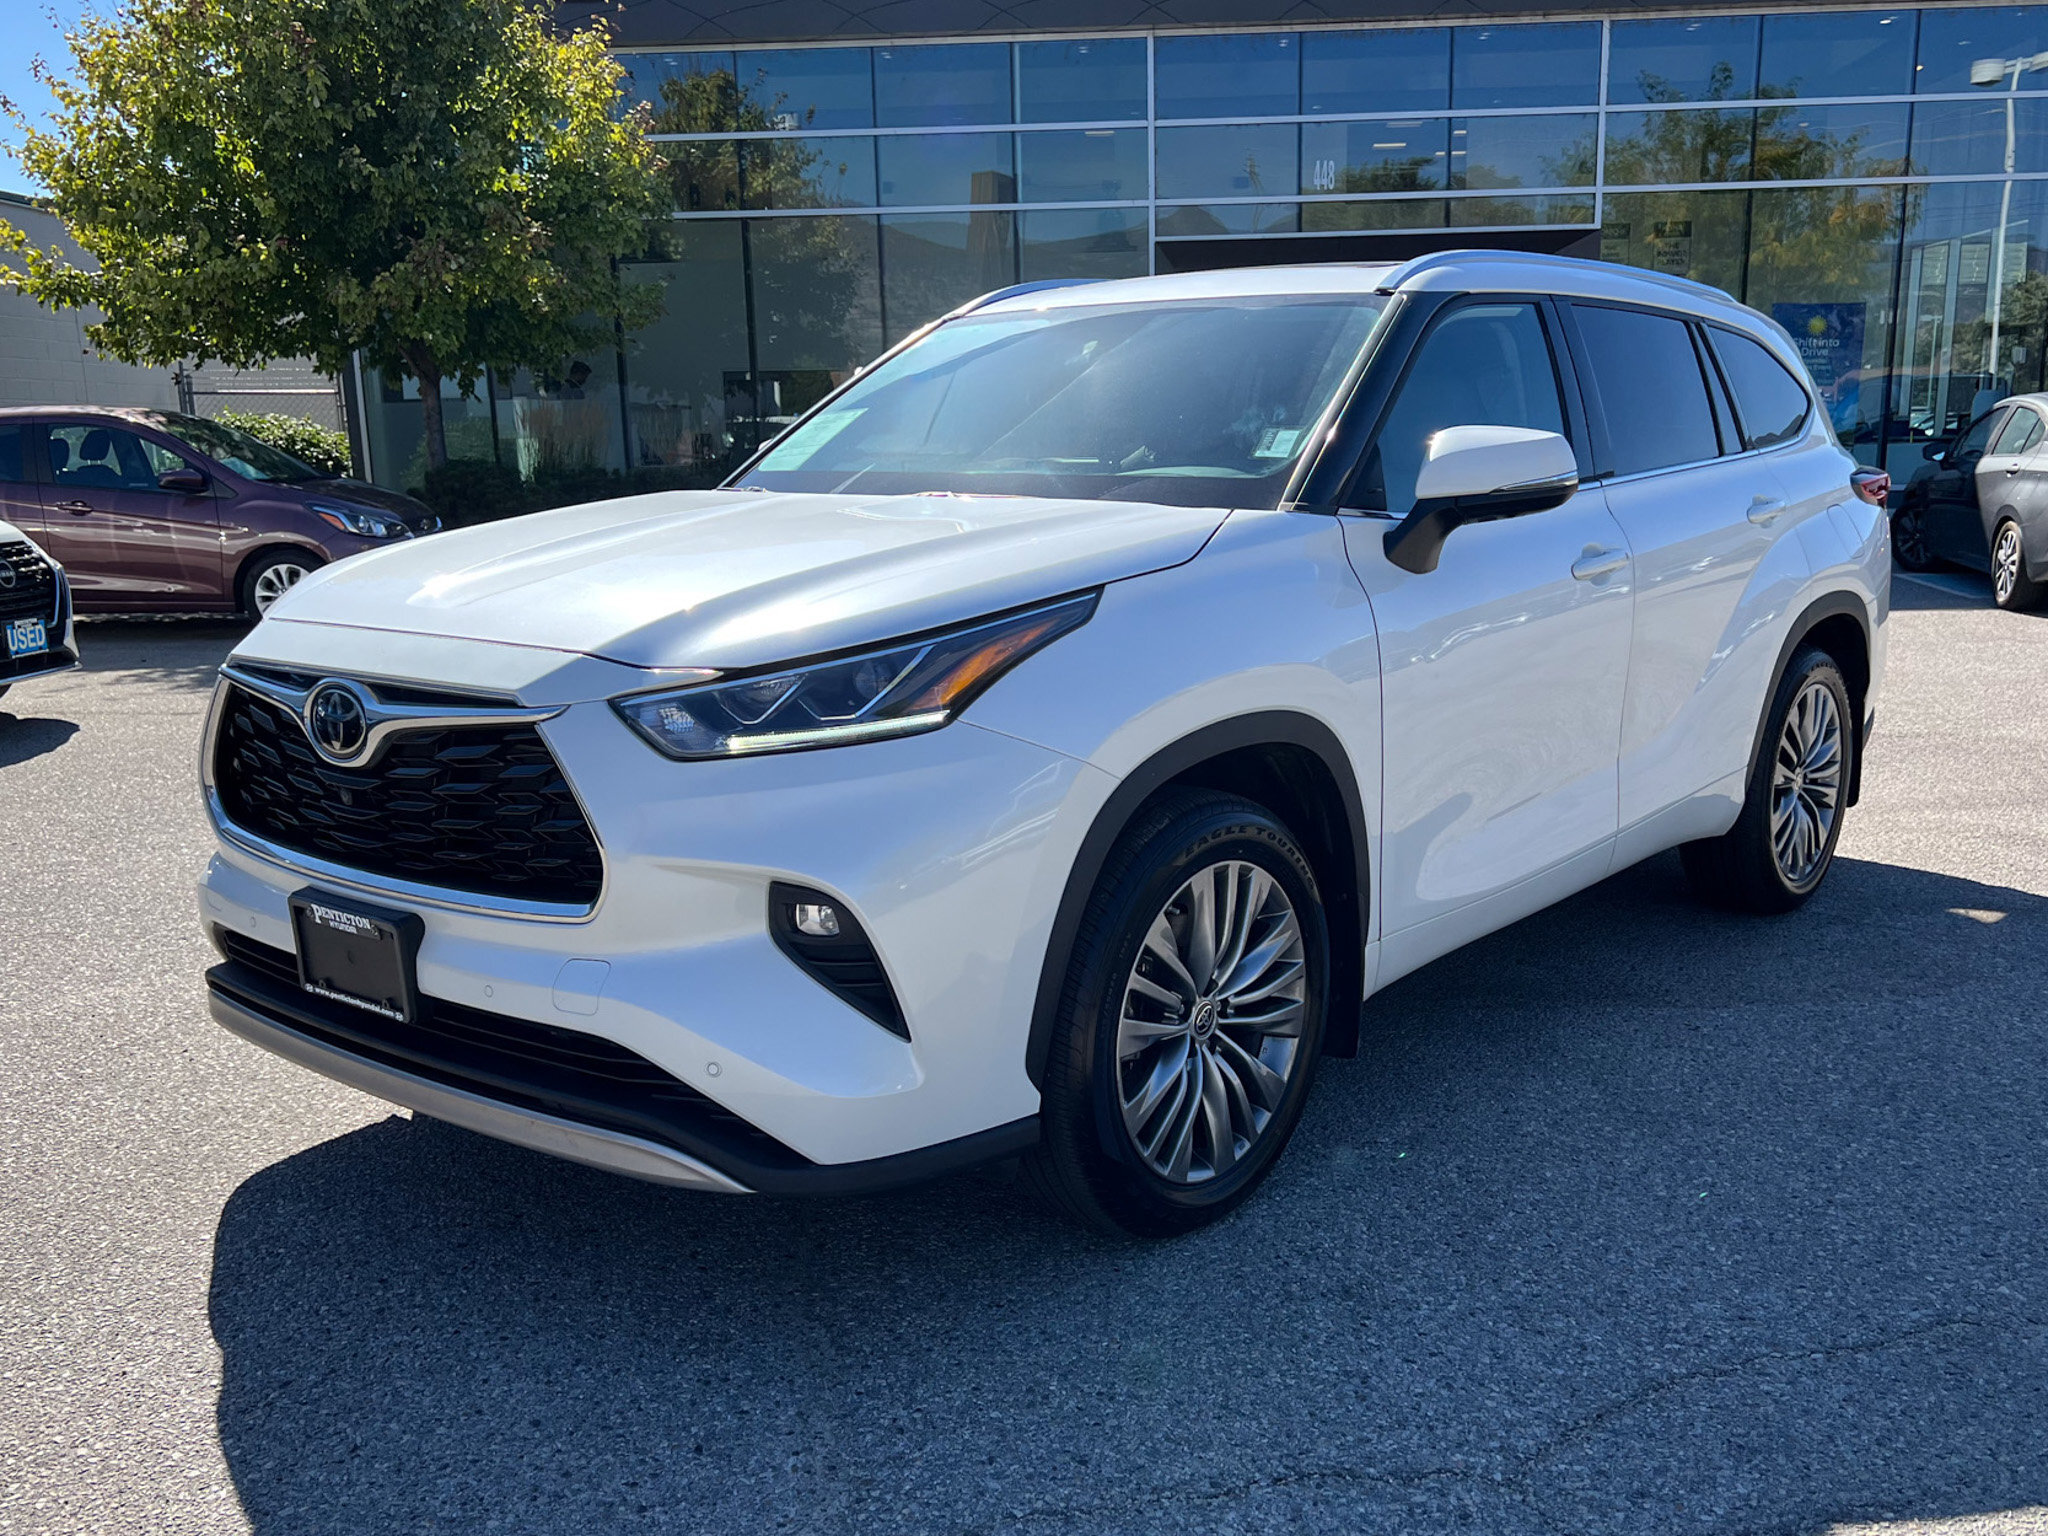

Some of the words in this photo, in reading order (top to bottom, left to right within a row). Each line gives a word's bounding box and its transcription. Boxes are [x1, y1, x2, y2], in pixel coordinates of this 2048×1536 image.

[1313, 160, 1335, 190] 448
[1802, 347, 1829, 356] Drive
[1819, 337, 1840, 347] into
[7, 624, 45, 651] USED
[1184, 825, 1247, 859] EAGLE
[310, 903, 371, 930] PENTICTON
